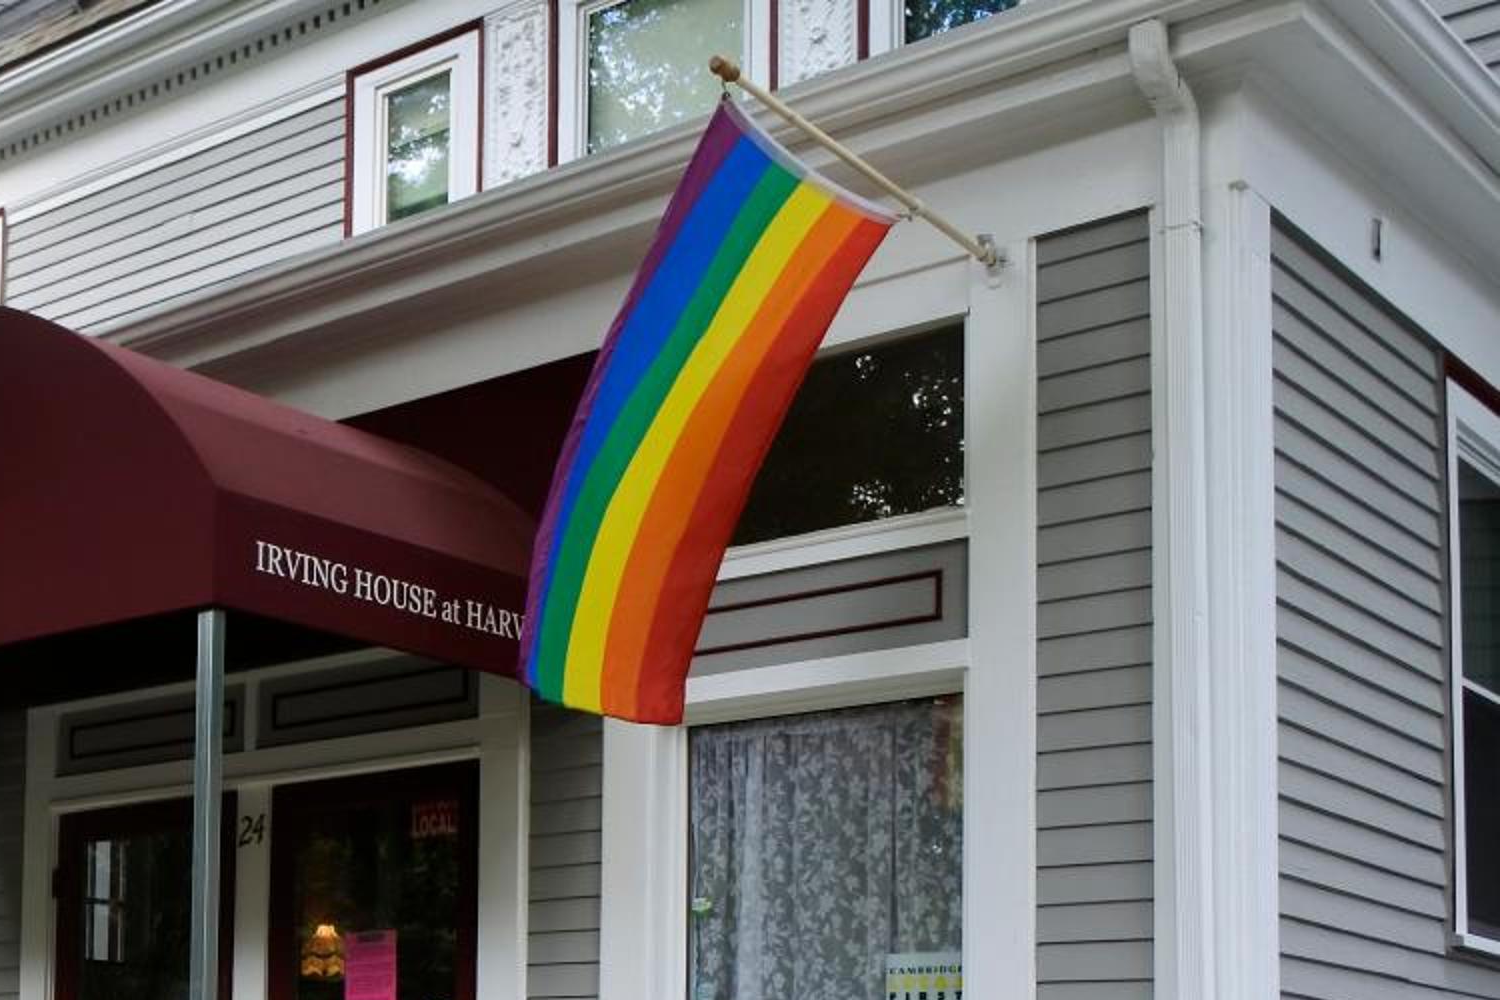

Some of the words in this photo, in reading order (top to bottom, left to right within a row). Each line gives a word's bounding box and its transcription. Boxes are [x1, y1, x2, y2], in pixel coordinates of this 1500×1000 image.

[255, 540, 349, 594] IRVING
[354, 568, 437, 619] HOUSE
[441, 600, 461, 625] at
[239, 813, 267, 848] 24
